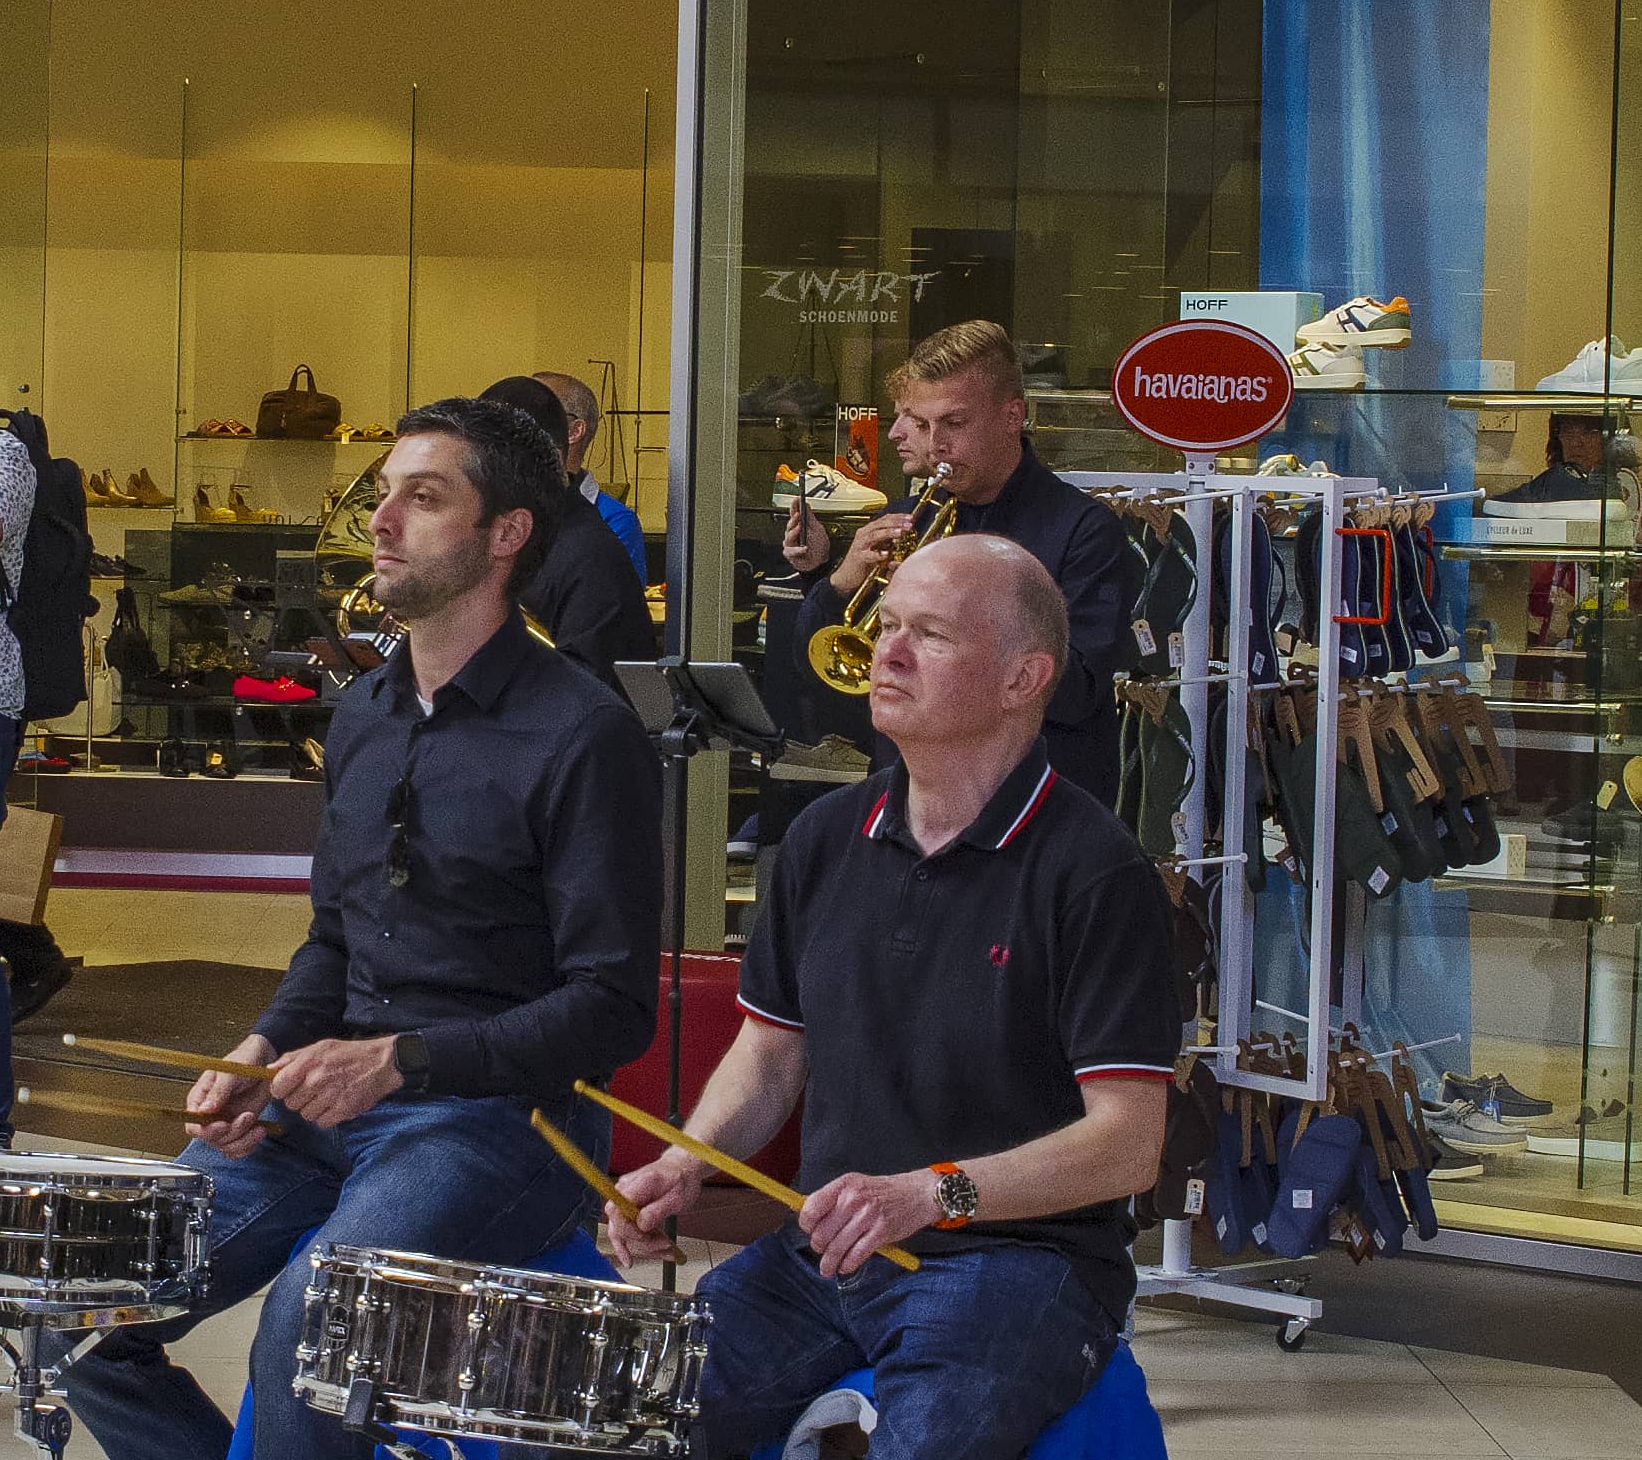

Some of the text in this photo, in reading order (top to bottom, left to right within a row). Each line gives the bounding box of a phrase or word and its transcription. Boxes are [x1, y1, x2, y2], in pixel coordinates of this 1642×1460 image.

[759, 268, 942, 304] ZWART
[1185, 299, 1229, 311] HOFF
[799, 310, 899, 324] SCHOENMODE
[1134, 366, 1268, 404] havaianas
[838, 406, 878, 420] HOFF
